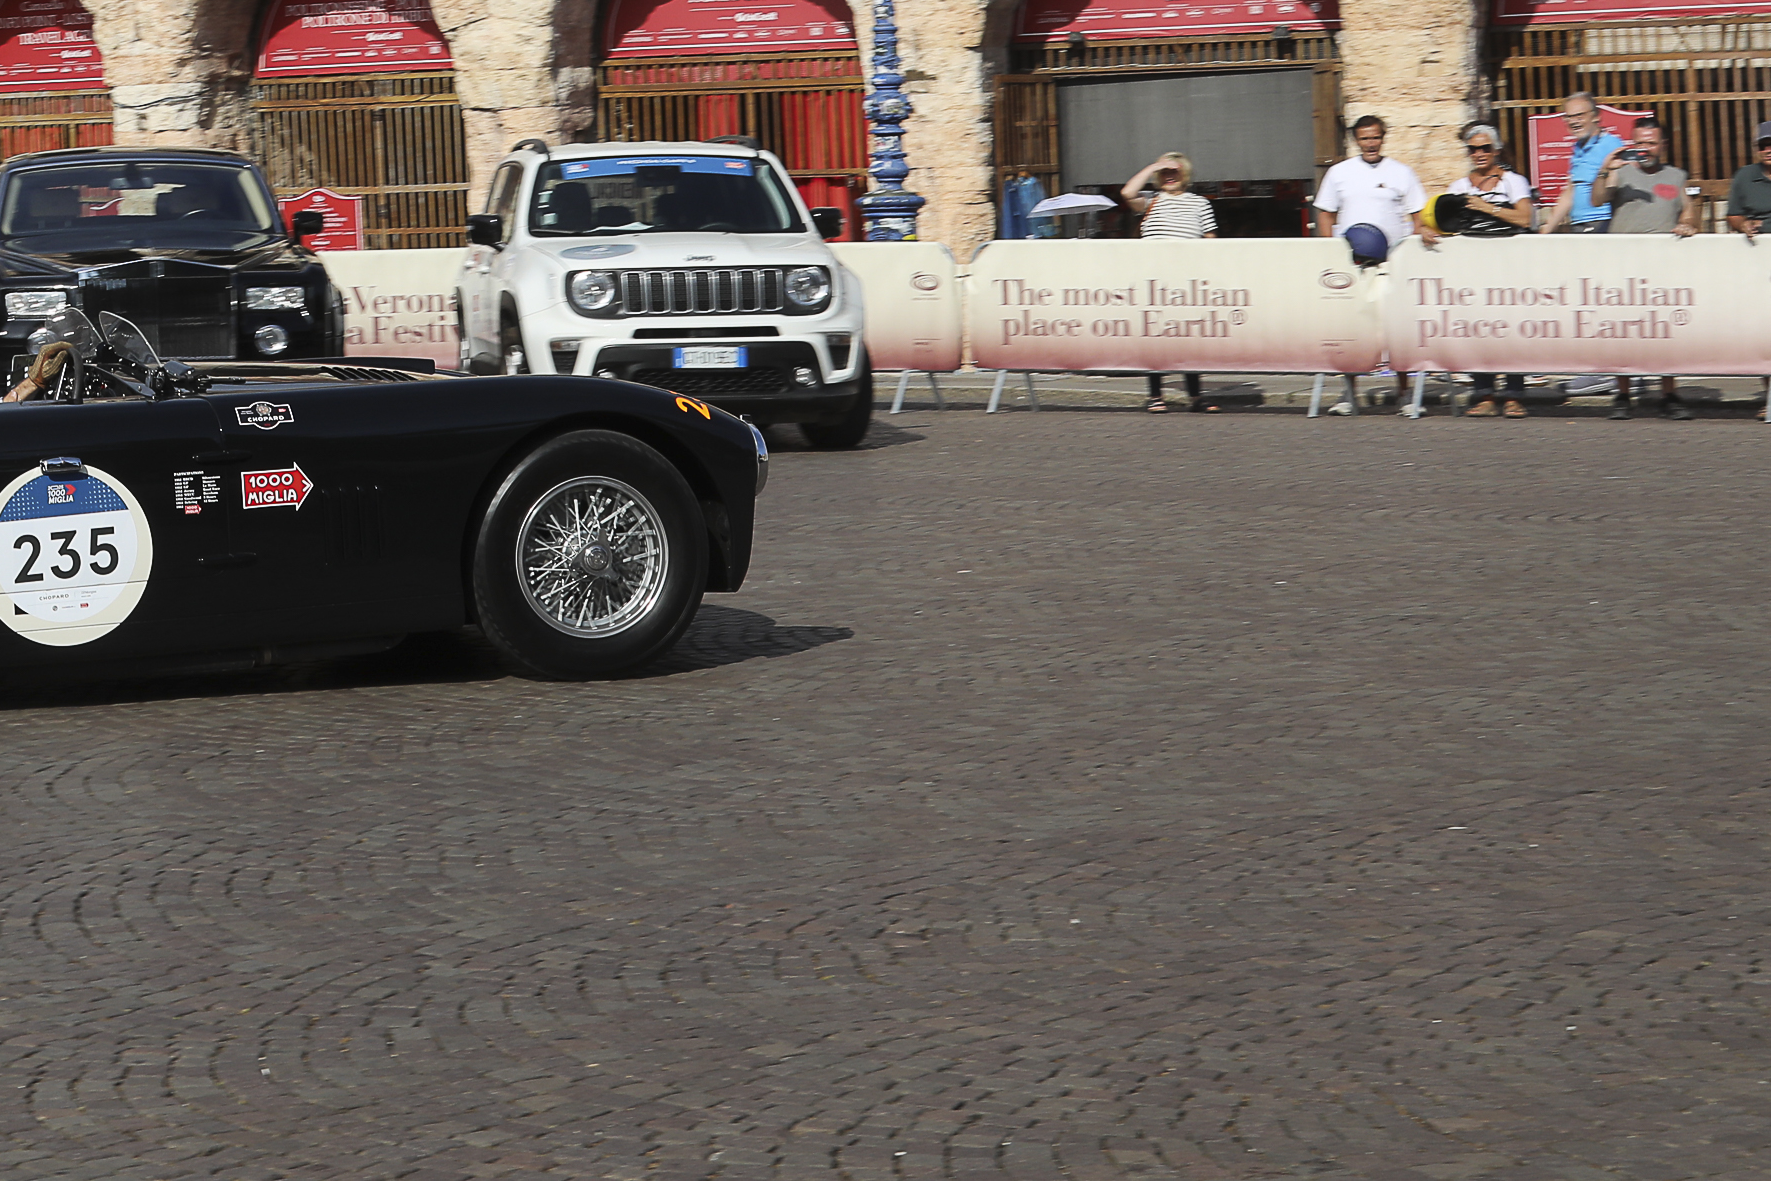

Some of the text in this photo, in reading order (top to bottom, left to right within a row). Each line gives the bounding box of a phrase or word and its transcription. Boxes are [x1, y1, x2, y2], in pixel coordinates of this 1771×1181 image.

[992, 278, 1253, 307] The most Italian
[1408, 277, 1697, 307] The most Italian
[1000, 309, 1082, 346] place
[1091, 317, 1133, 338] on
[1416, 309, 1511, 348] place
[1518, 318, 1564, 338] on
[248, 472, 294, 489] 1000
[48, 489, 66, 498] 1000
[48, 494, 75, 505] MIGLIA
[247, 488, 298, 505] MIGLIA
[13, 526, 120, 585] 235
[39, 593, 70, 601] CHOPARD
